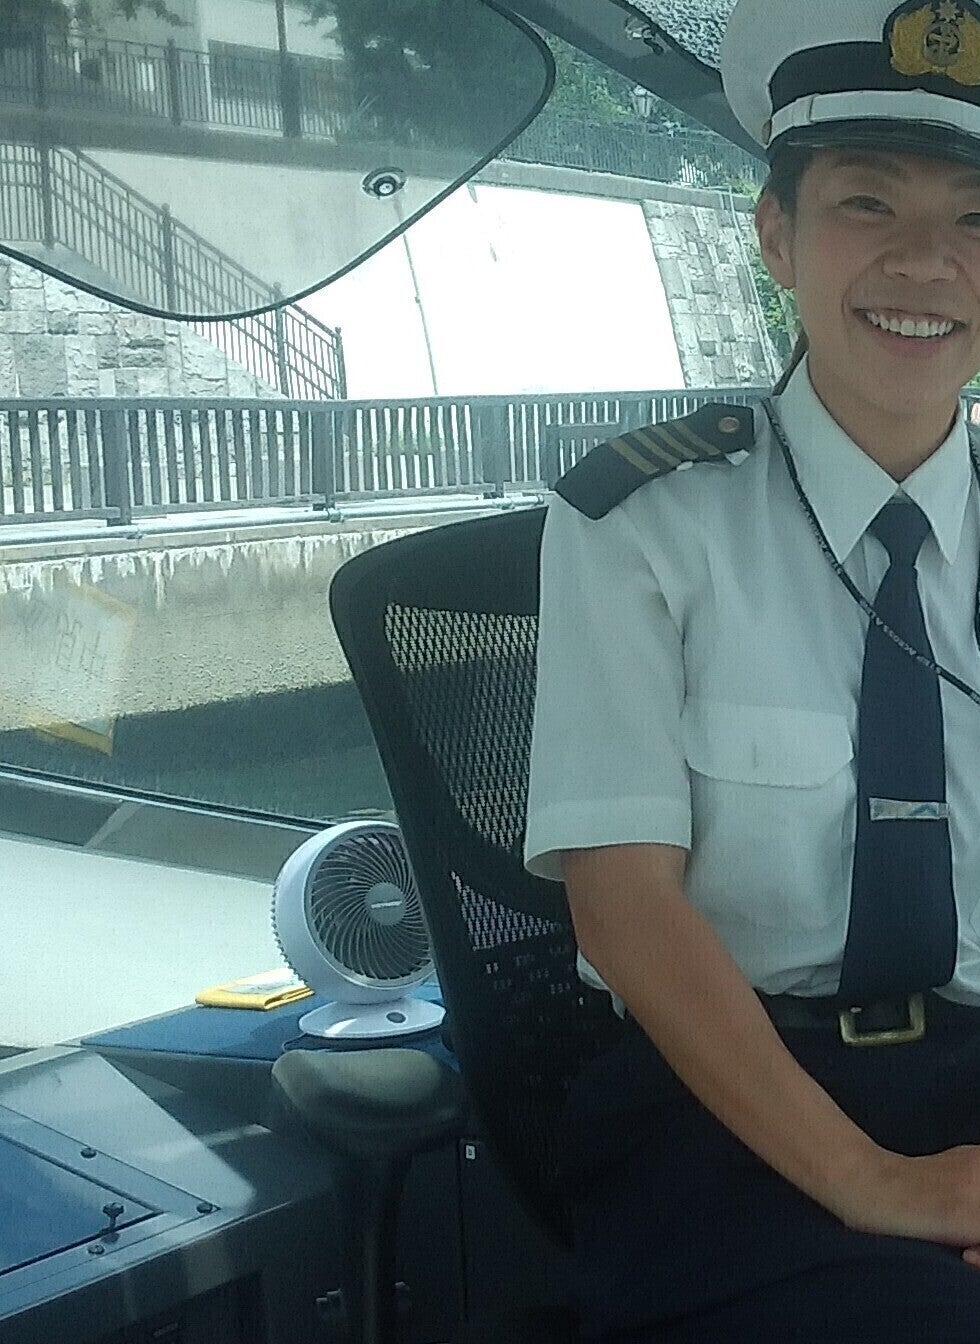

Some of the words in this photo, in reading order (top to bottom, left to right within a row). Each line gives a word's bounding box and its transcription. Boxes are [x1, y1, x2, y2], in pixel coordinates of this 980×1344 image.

[872, 616, 884, 627] A
[880, 624, 917, 657] ACROSS
[915, 653, 943, 675] STEP
